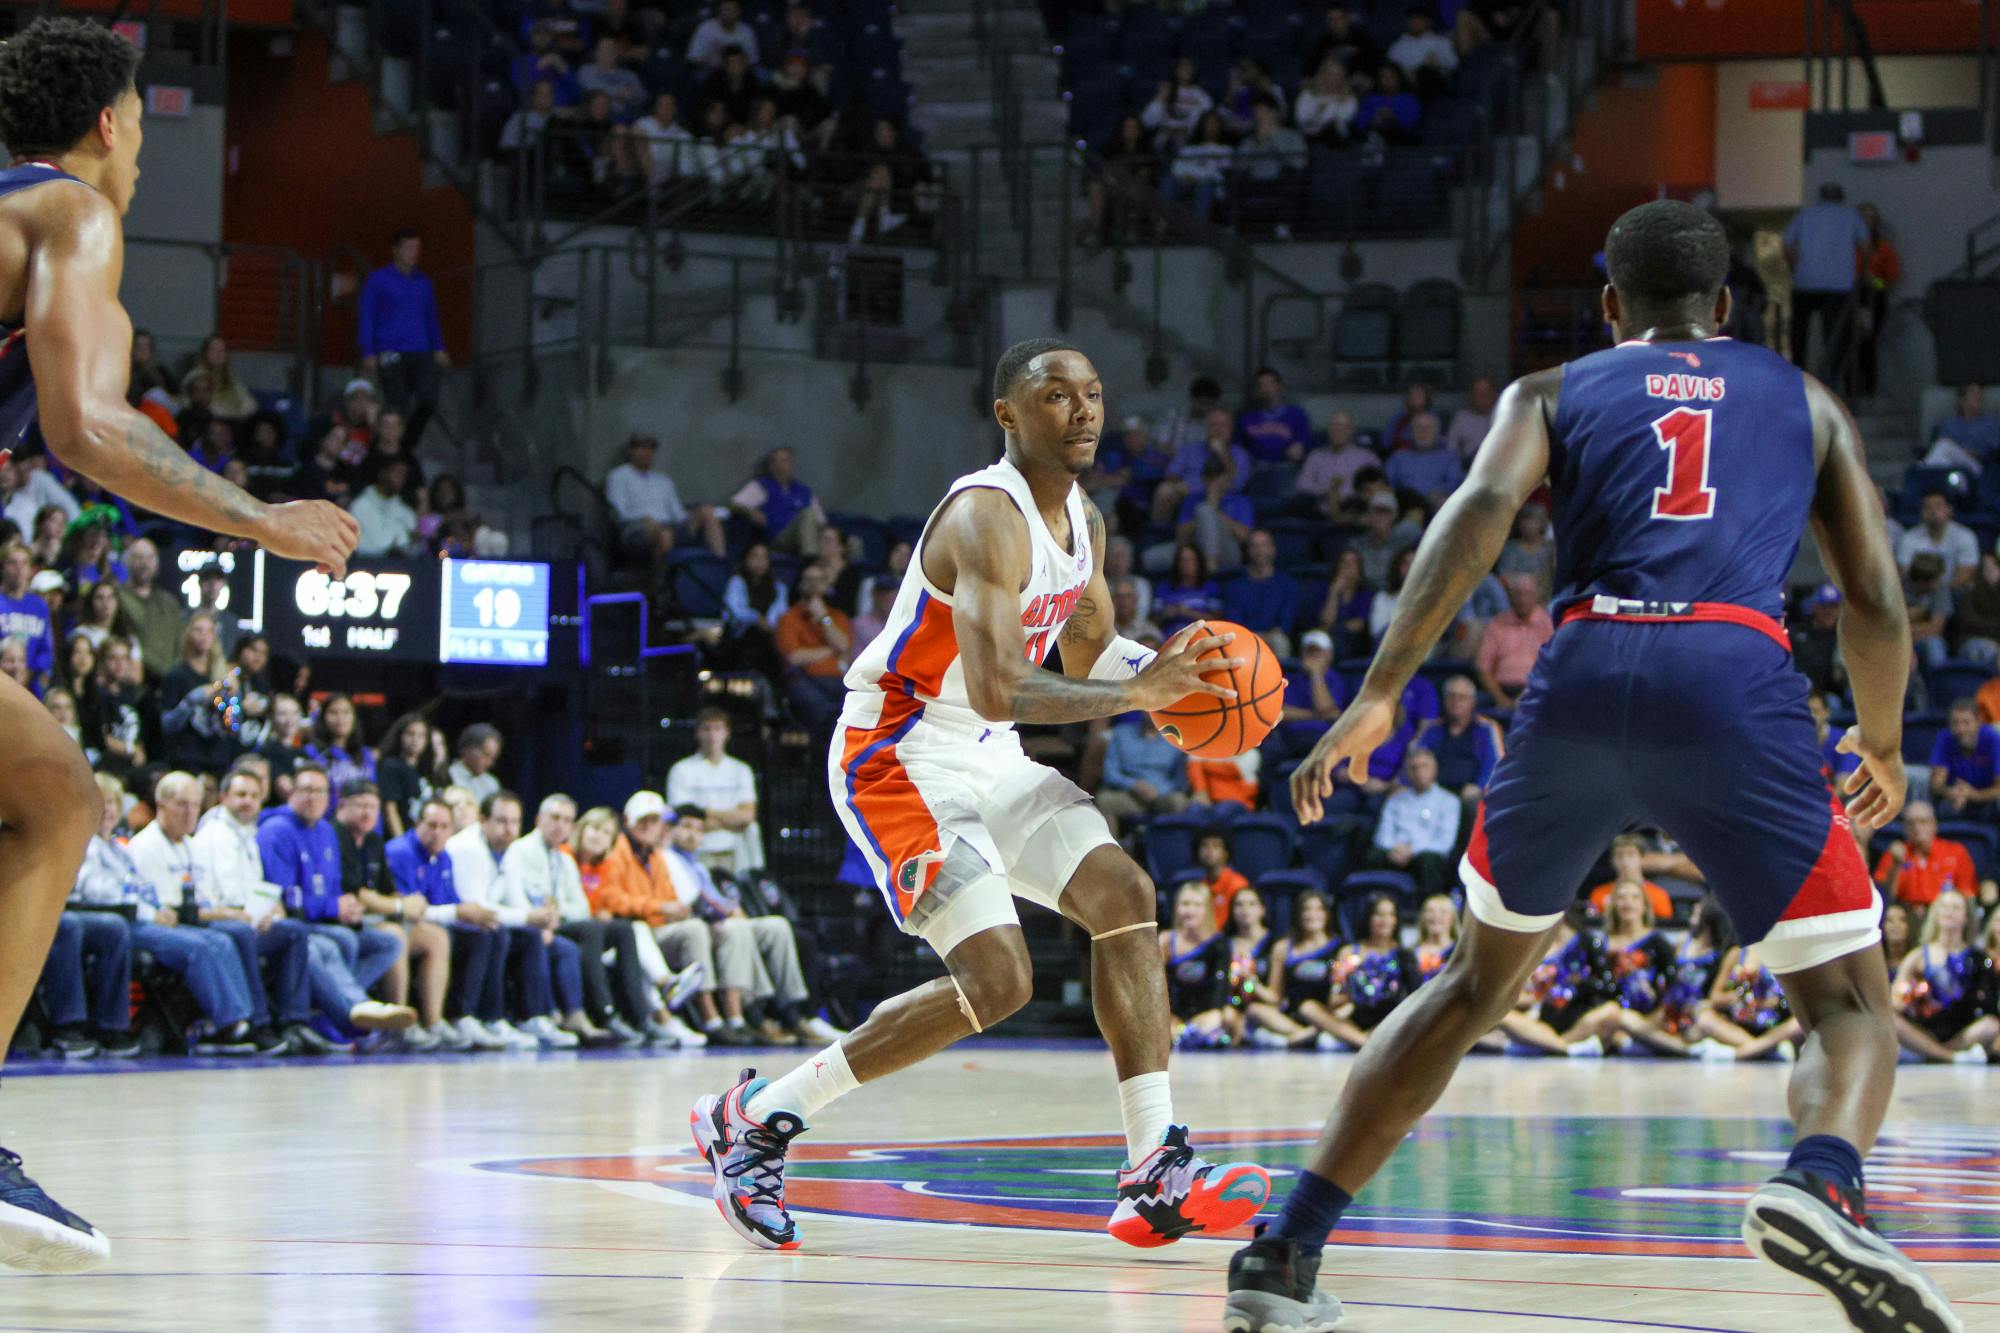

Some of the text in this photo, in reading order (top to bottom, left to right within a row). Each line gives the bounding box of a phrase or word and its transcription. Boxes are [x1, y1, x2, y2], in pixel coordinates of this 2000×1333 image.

[1645, 373, 1726, 401] DAVIS
[1649, 406, 1717, 521] 1
[295, 568, 411, 620] 6:37
[473, 587, 522, 628] 19
